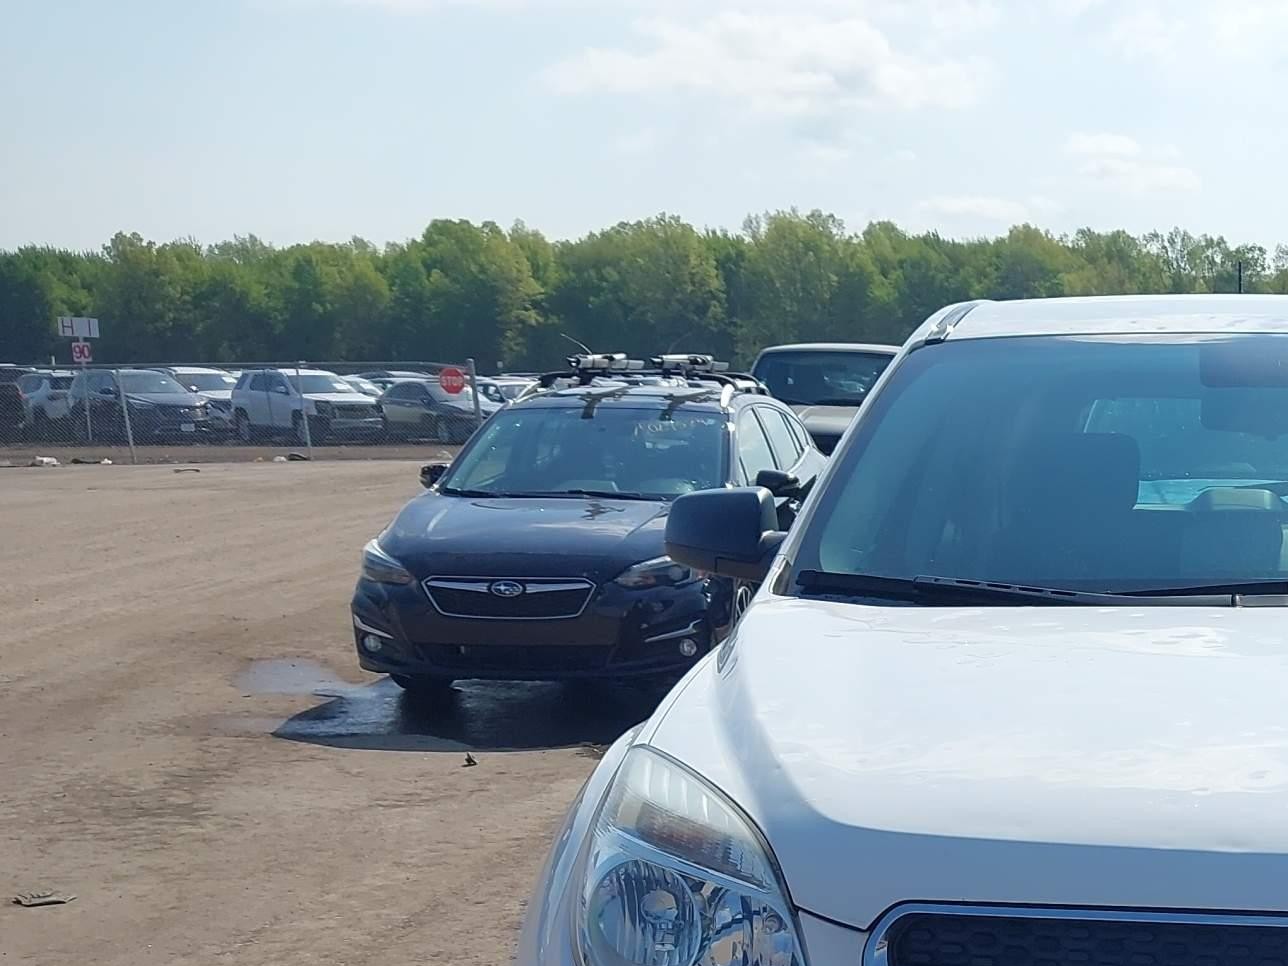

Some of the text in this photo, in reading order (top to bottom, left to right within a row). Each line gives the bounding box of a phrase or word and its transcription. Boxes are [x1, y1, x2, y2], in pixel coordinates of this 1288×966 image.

[61, 319, 74, 336] H
[74, 345, 90, 359] 90
[441, 375, 464, 386] STOP
